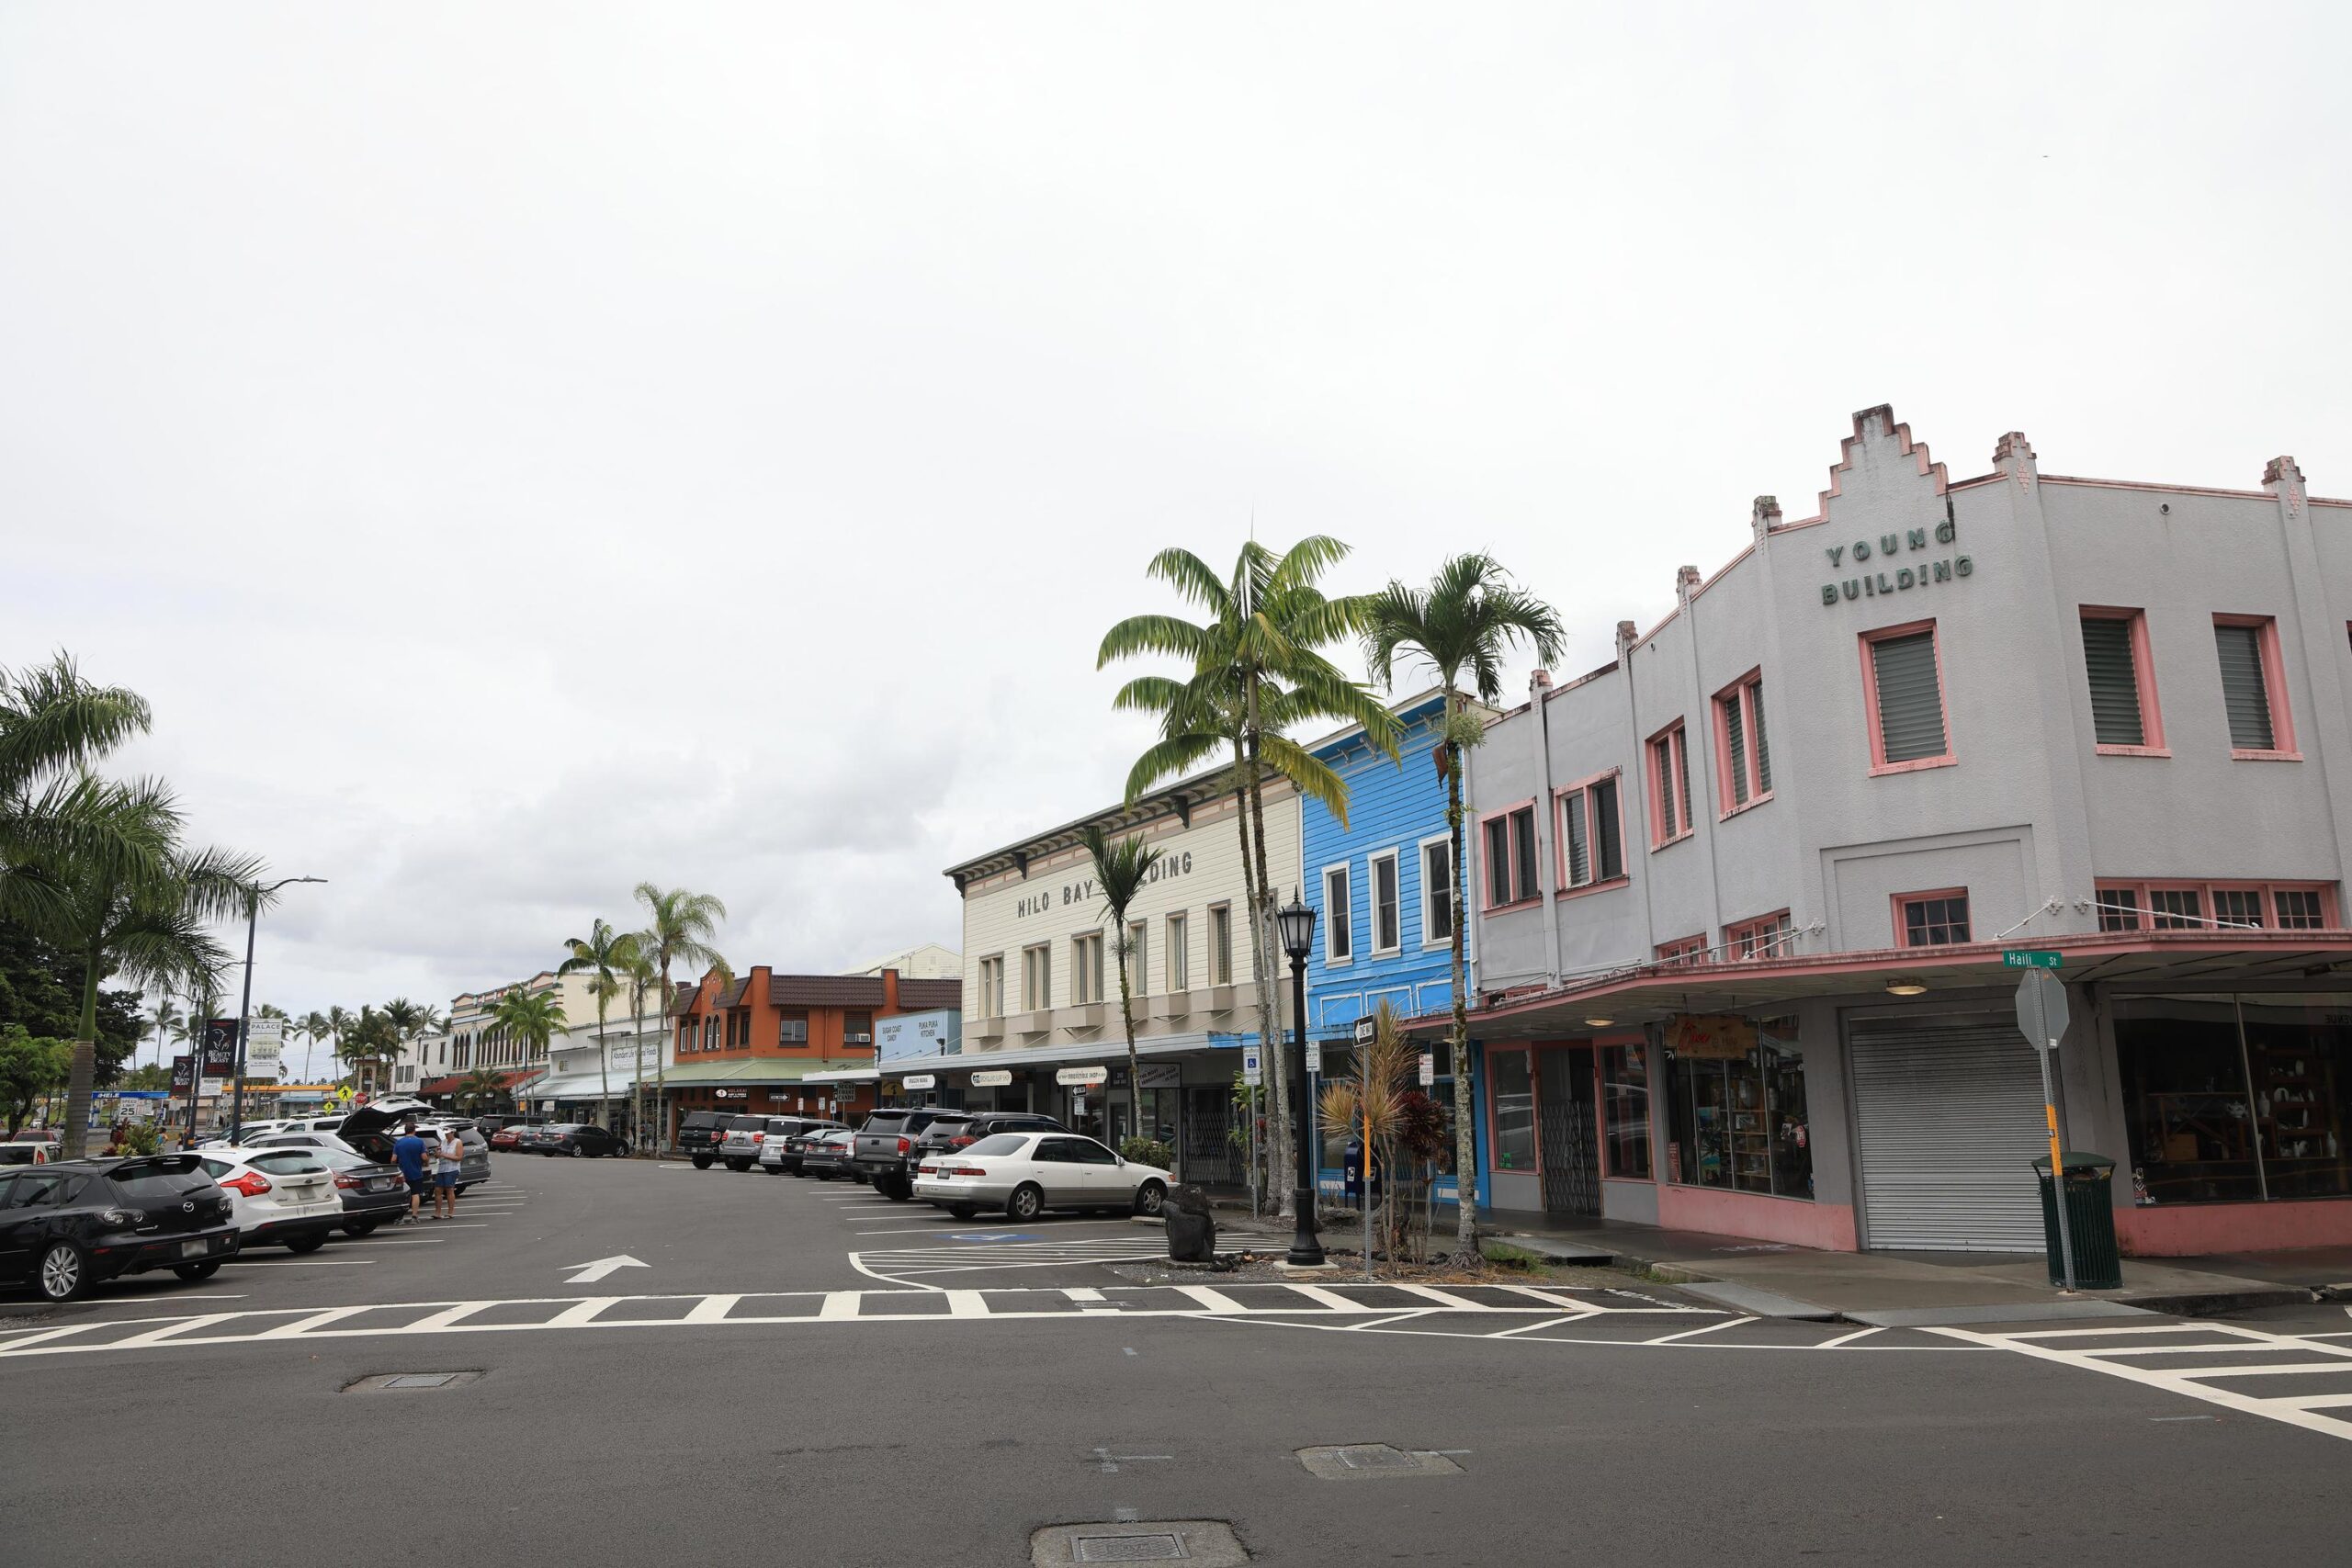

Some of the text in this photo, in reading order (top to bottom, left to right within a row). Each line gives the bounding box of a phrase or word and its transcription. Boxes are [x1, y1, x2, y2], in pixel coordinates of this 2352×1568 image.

[1825, 520, 1953, 567] YOUNG
[1822, 554, 1973, 605] BUILDING
[1018, 891, 1049, 918] HILO
[1063, 879, 1092, 905] BAY
[2008, 953, 2057, 965] Haili St
